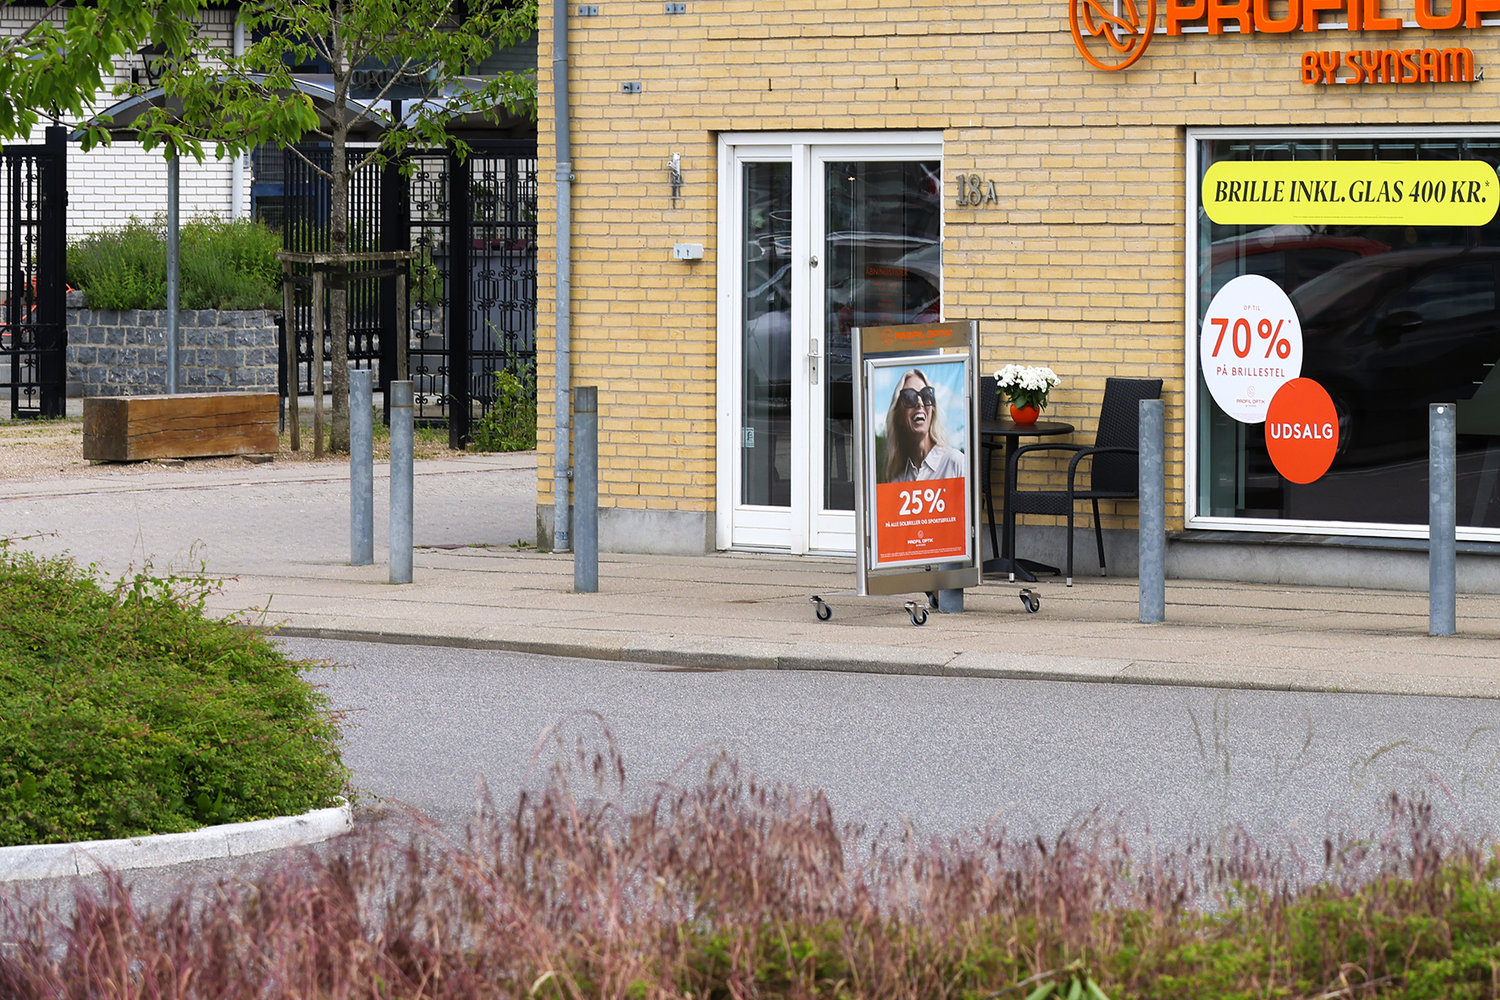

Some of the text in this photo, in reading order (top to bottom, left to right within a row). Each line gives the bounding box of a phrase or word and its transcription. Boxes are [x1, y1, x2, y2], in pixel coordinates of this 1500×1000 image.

[1302, 48, 1473, 85] BY SYNSAM
[956, 174, 998, 206] 18A
[1214, 180, 1285, 203] BRILLE
[1289, 180, 1346, 203] INKL.
[1349, 180, 1404, 203] GLAS
[1409, 180, 1446, 203] 400
[1217, 364, 1285, 377] PÅ BRILLESTEL
[1271, 423, 1333, 439] UDSALG
